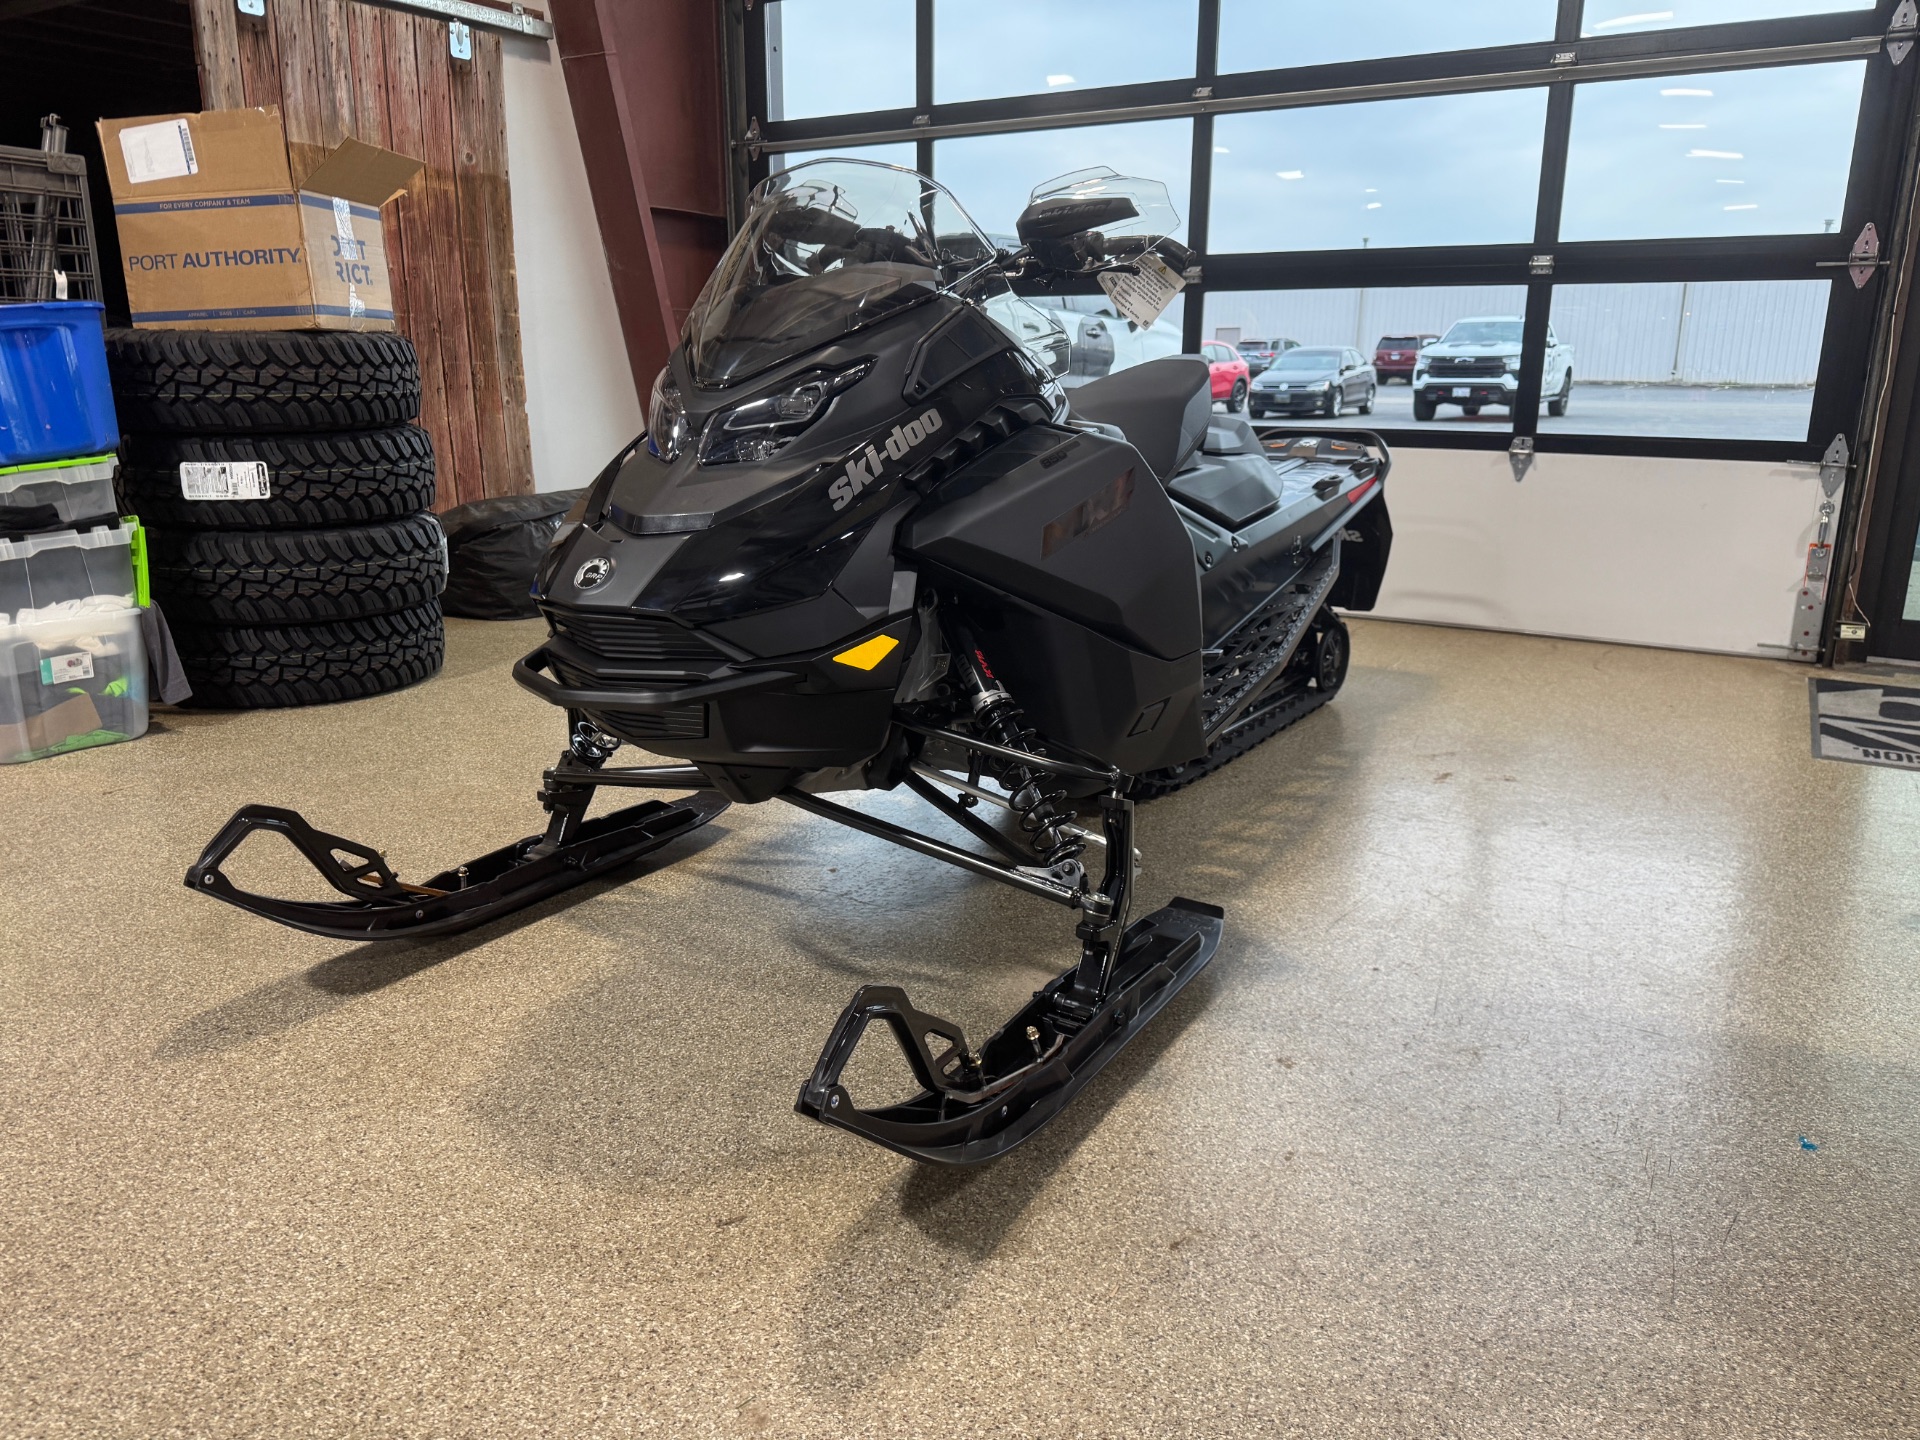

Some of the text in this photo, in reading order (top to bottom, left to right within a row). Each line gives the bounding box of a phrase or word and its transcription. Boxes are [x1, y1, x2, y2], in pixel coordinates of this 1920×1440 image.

[159, 198, 251, 210] FOR EVERY COMPANY & TEAM
[128, 247, 301, 272] PORT AUTHORITY
[828, 407, 943, 512] ski-doo
[1040, 450, 1068, 470] 850
